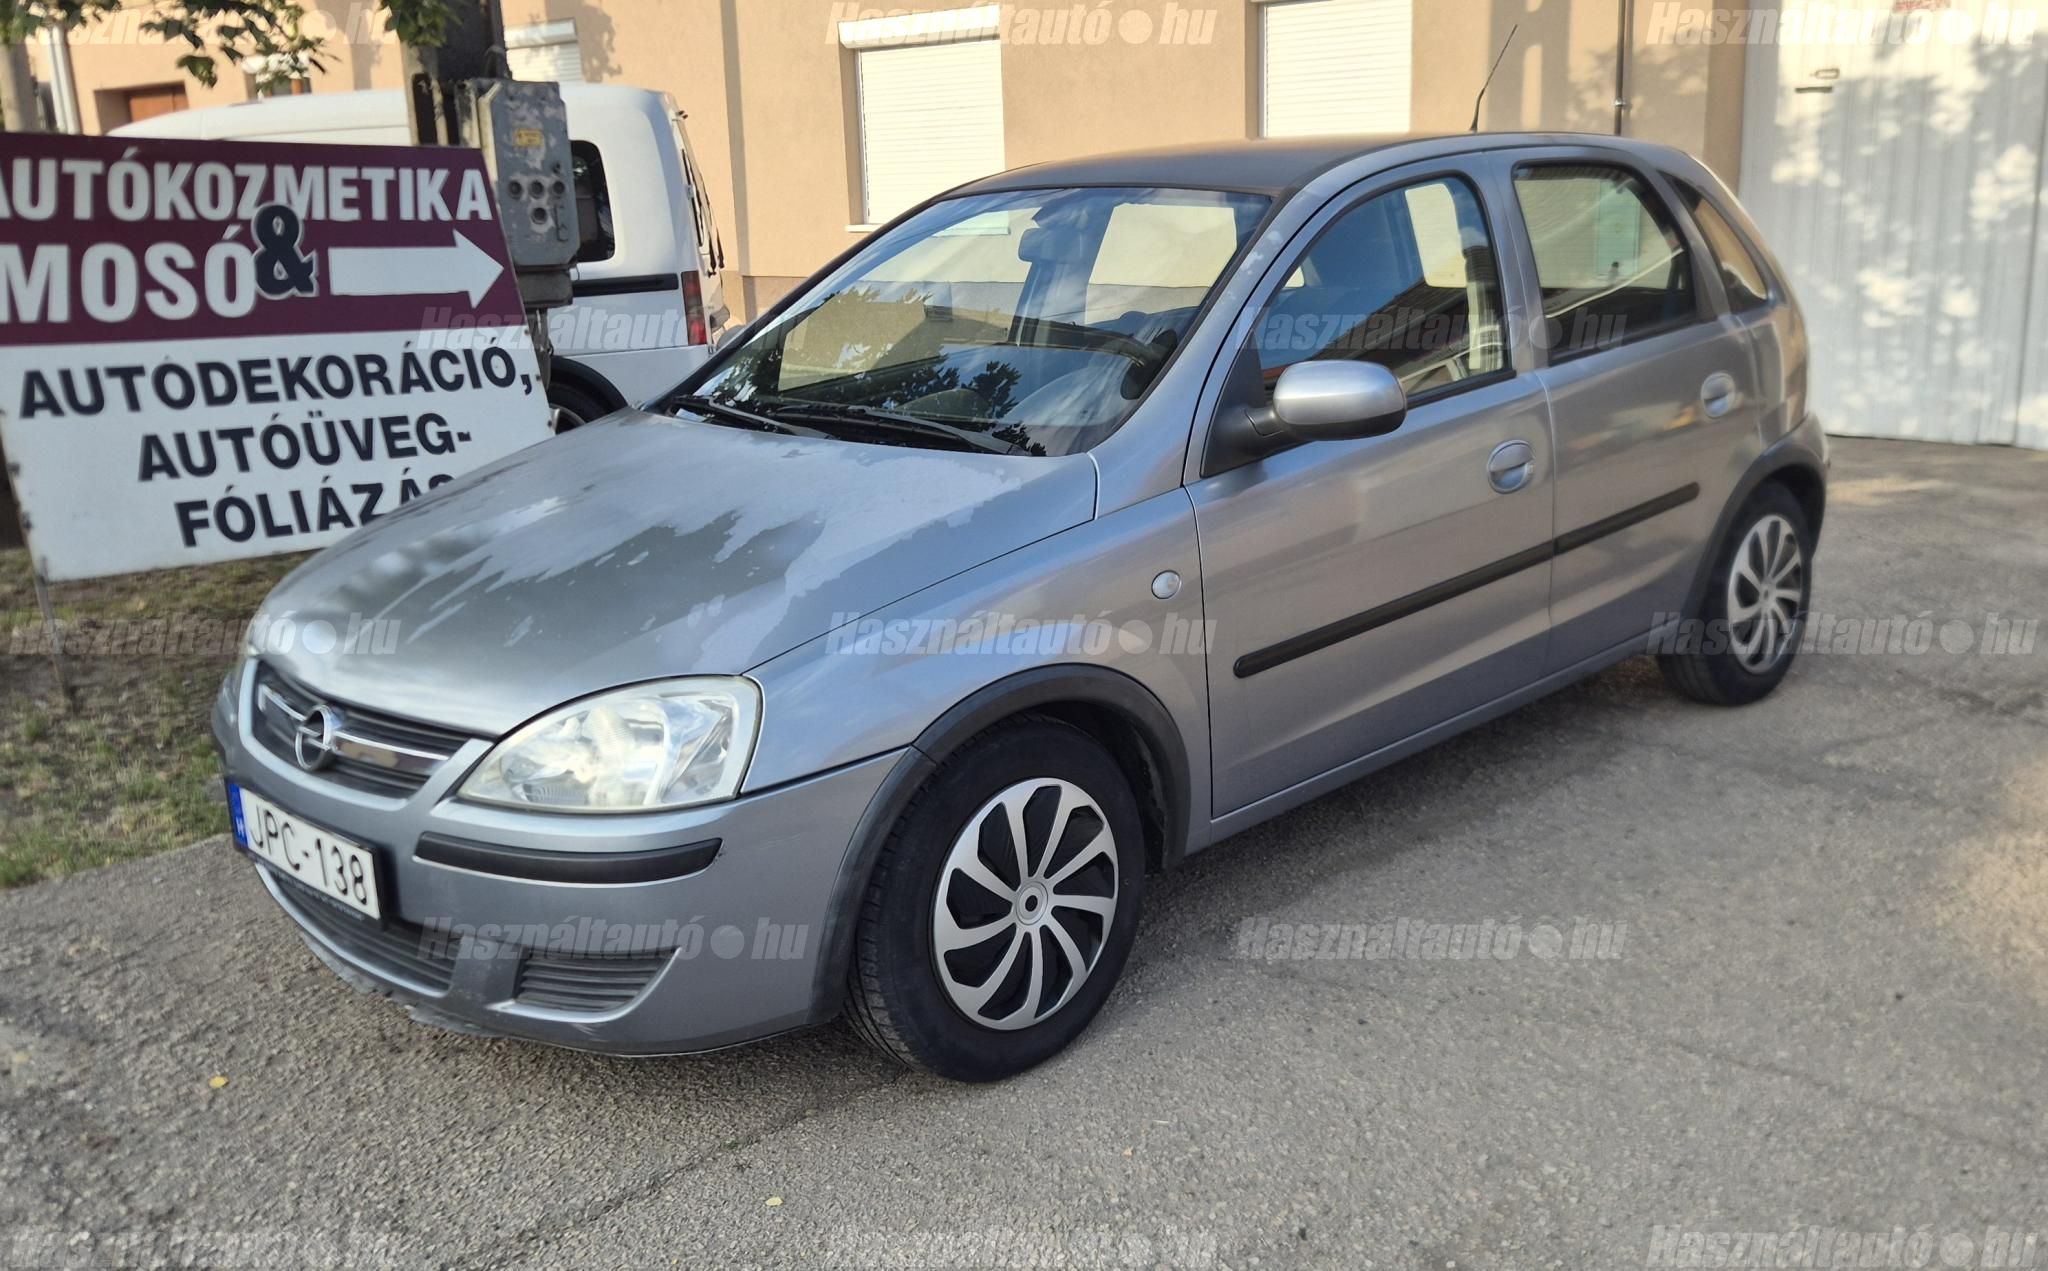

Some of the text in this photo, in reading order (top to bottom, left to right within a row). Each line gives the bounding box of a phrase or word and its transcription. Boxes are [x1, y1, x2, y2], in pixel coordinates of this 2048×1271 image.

[0, 202, 319, 323] MOSÓ &
[138, 411, 472, 482] AUTÓÜVEG-
[250, 804, 367, 906] JPC-138
